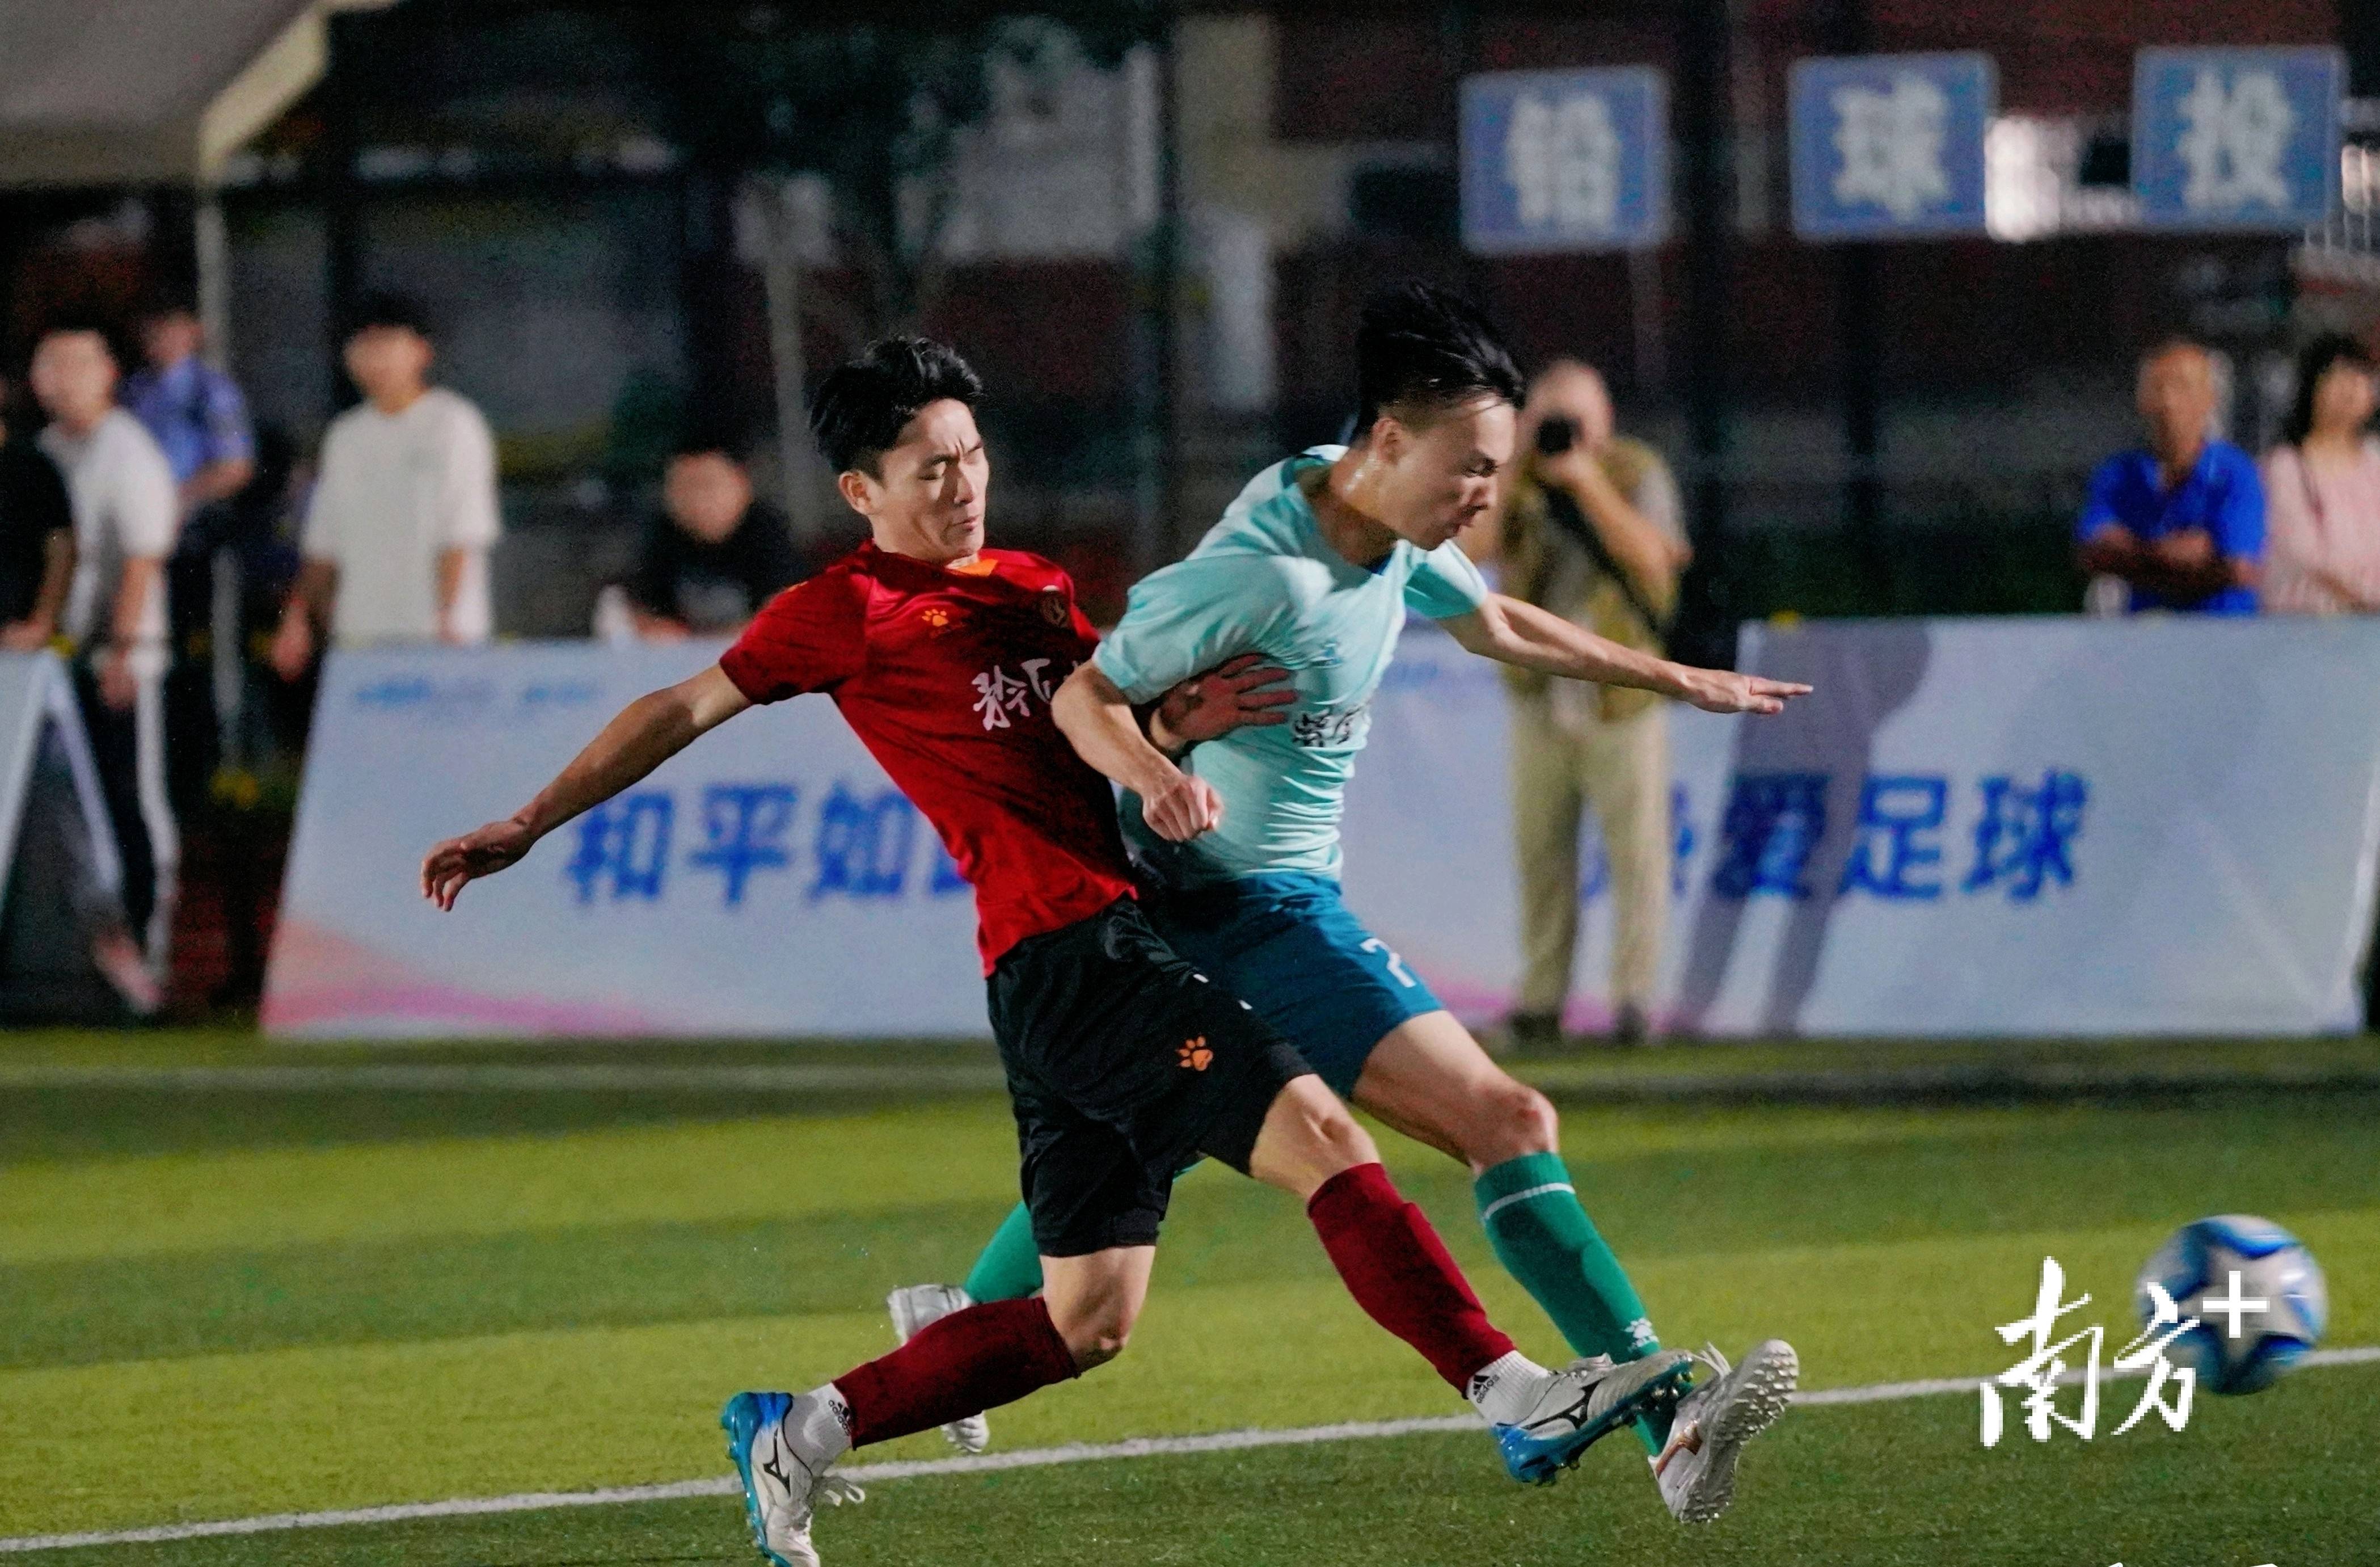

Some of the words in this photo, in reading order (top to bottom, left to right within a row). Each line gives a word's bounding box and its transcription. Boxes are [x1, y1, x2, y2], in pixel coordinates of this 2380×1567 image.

[564, 781, 973, 906] 和平如
[1581, 769, 2090, 903] 爱足球
[1476, 1374, 1500, 1404] adidas
